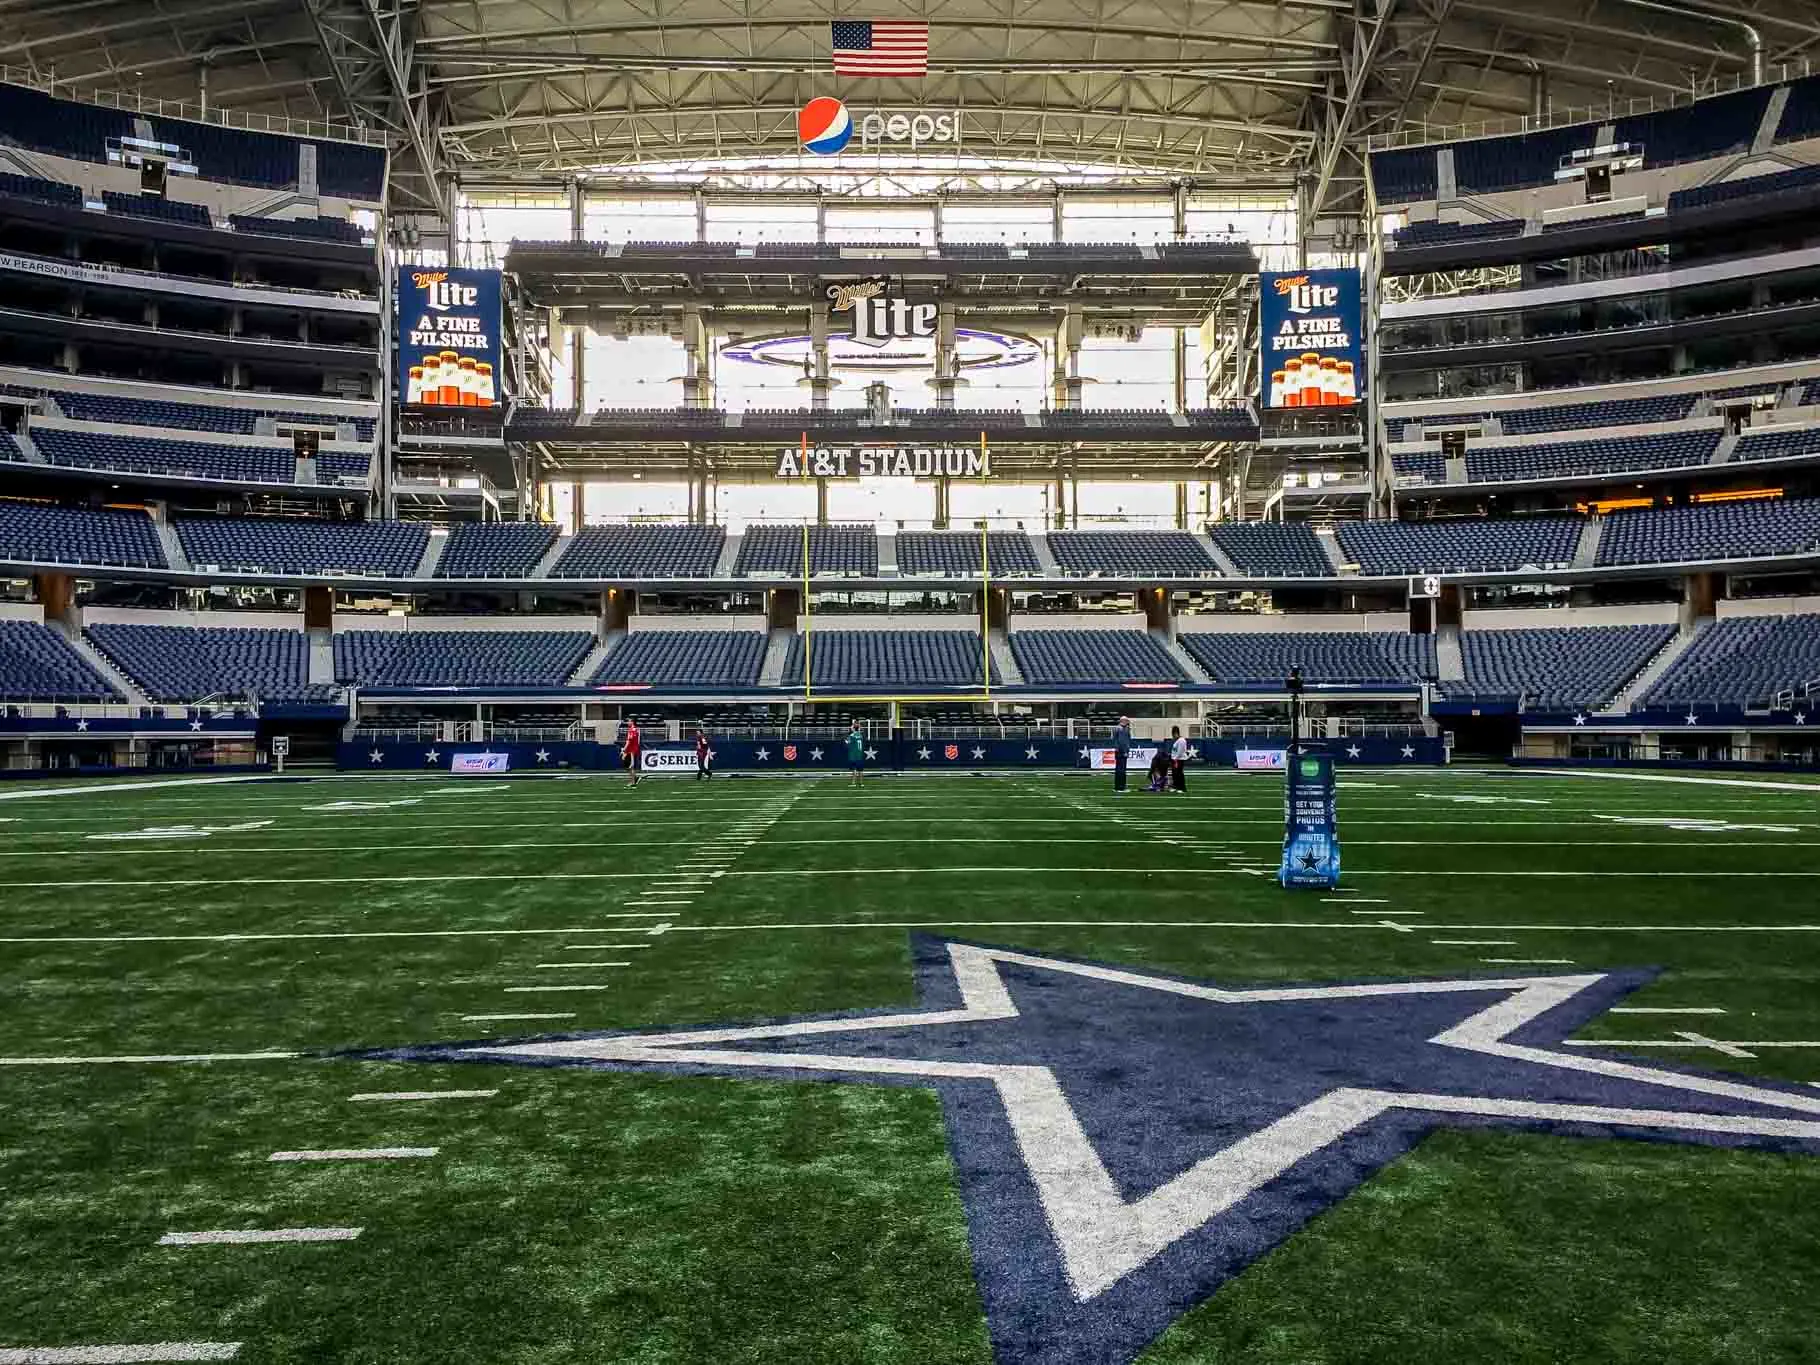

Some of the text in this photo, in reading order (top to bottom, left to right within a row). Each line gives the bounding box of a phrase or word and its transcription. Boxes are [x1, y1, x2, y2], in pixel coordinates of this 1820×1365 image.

[862, 111, 960, 150] pepsi
[14, 259, 68, 276] PEARSON
[411, 271, 449, 289] Miller
[426, 281, 479, 311] Lite
[826, 281, 886, 312] Miller
[1287, 285, 1339, 314] Lite
[418, 315, 481, 332] A FINE
[850, 296, 937, 348] Lite
[1280, 317, 1341, 334] A FINE
[410, 331, 489, 349] PILSNER
[1272, 333, 1350, 351] PILSNER
[777, 448, 991, 477] AT&T STADIUM
[644, 753, 698, 767] G SERIE
[1296, 816, 1326, 825] PHOTOS
